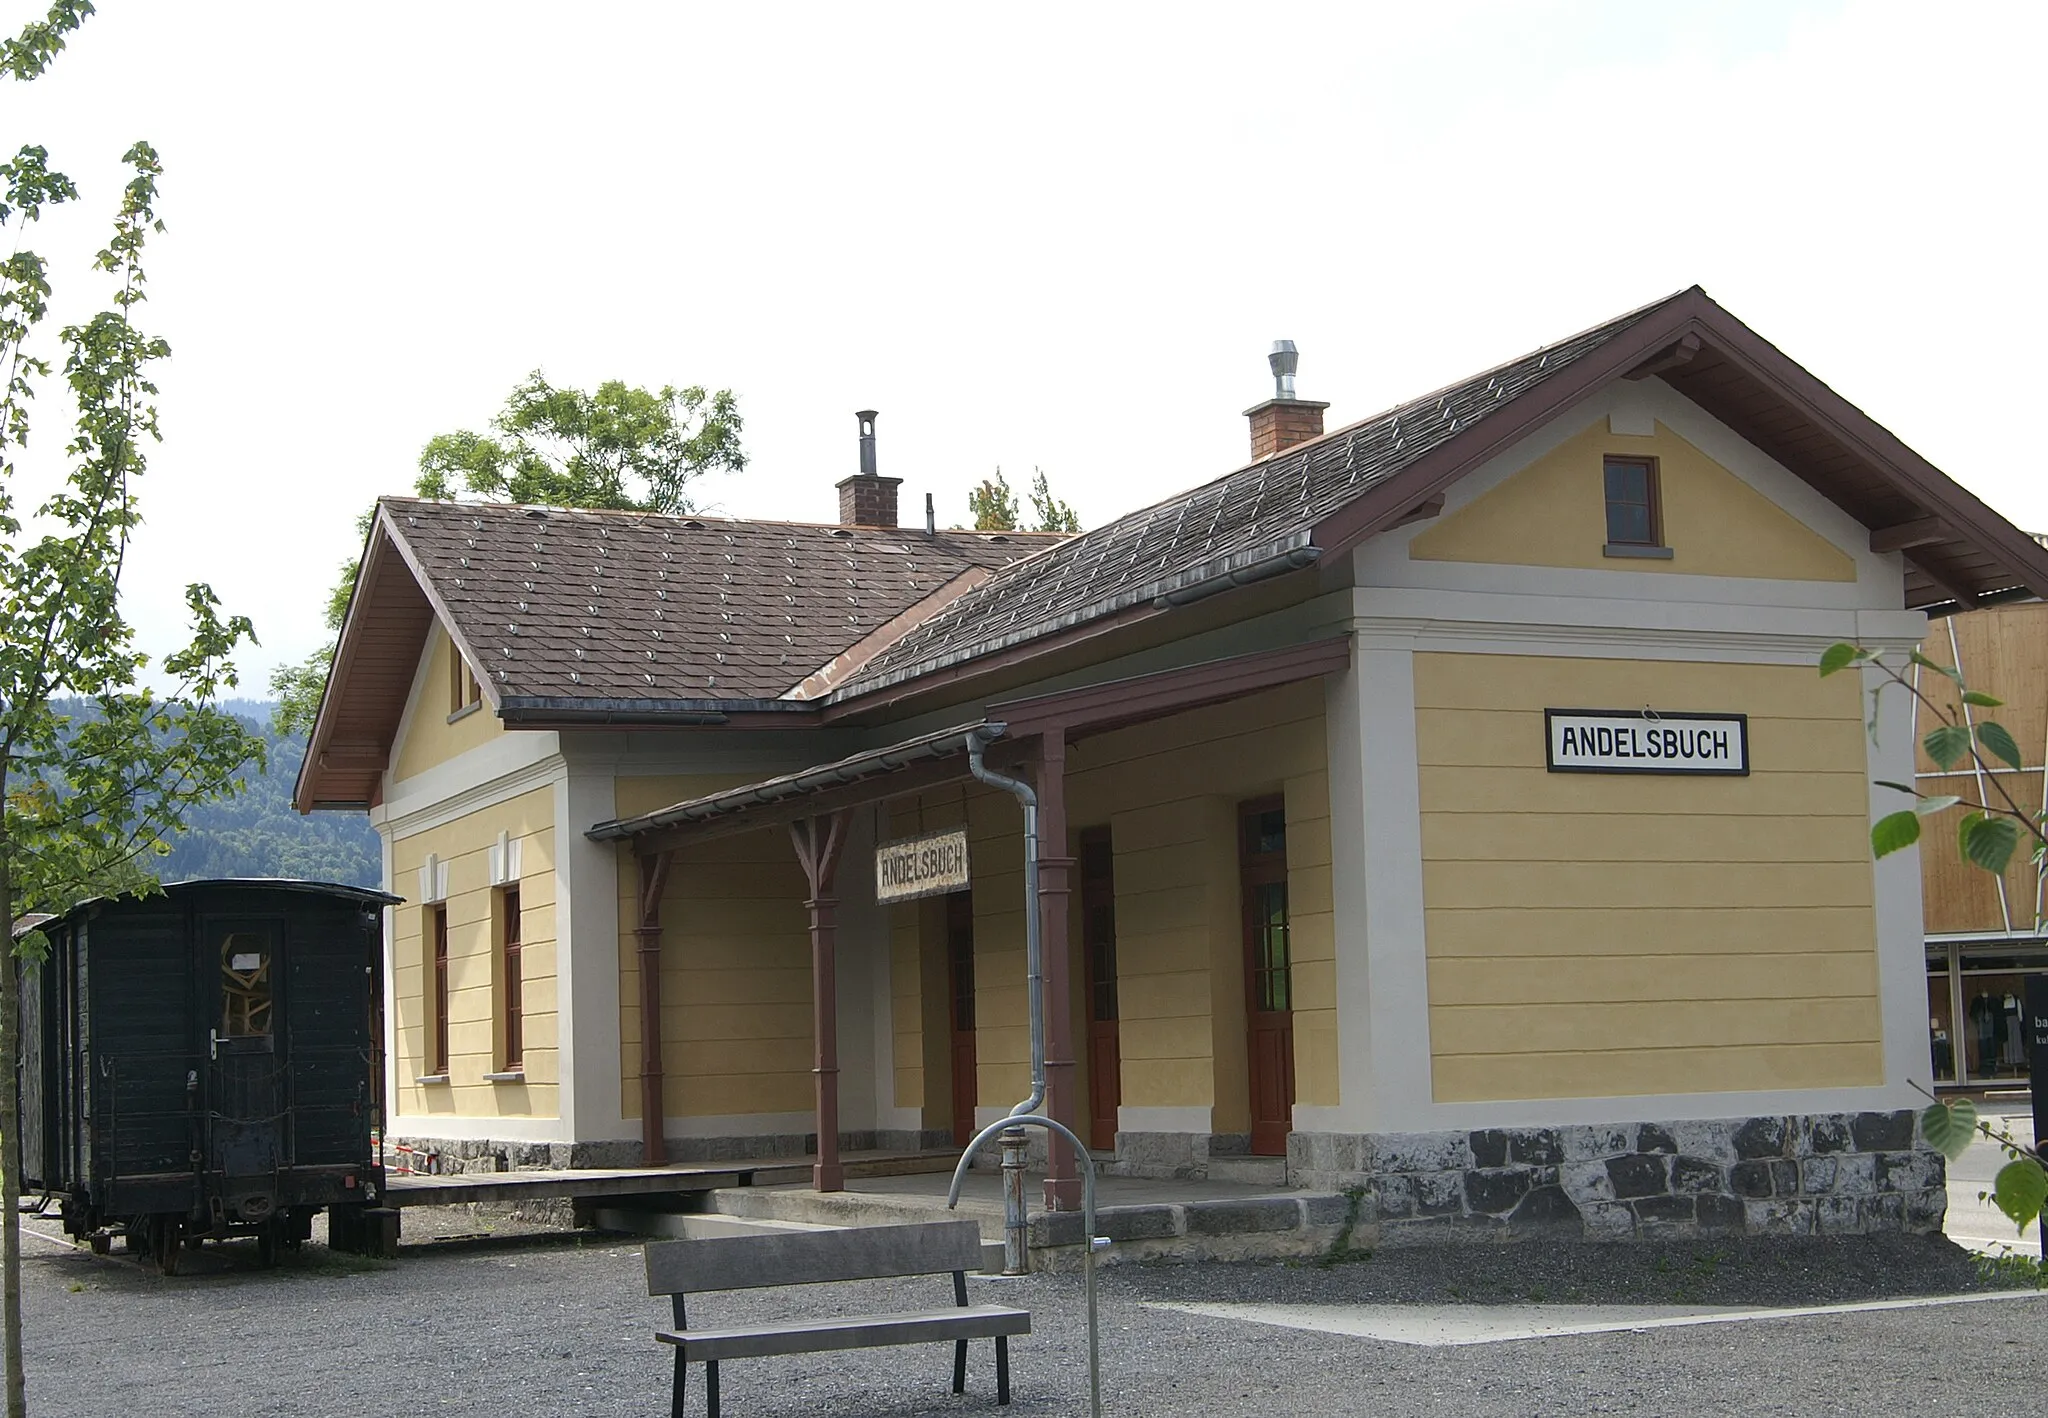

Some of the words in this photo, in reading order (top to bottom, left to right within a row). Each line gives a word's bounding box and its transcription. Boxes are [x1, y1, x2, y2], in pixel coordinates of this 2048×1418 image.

[1562, 727, 1728, 759] ANDELSBUCH
[882, 843, 962, 887] ANDELSBUCH
[2035, 1016, 2048, 1028] ba
